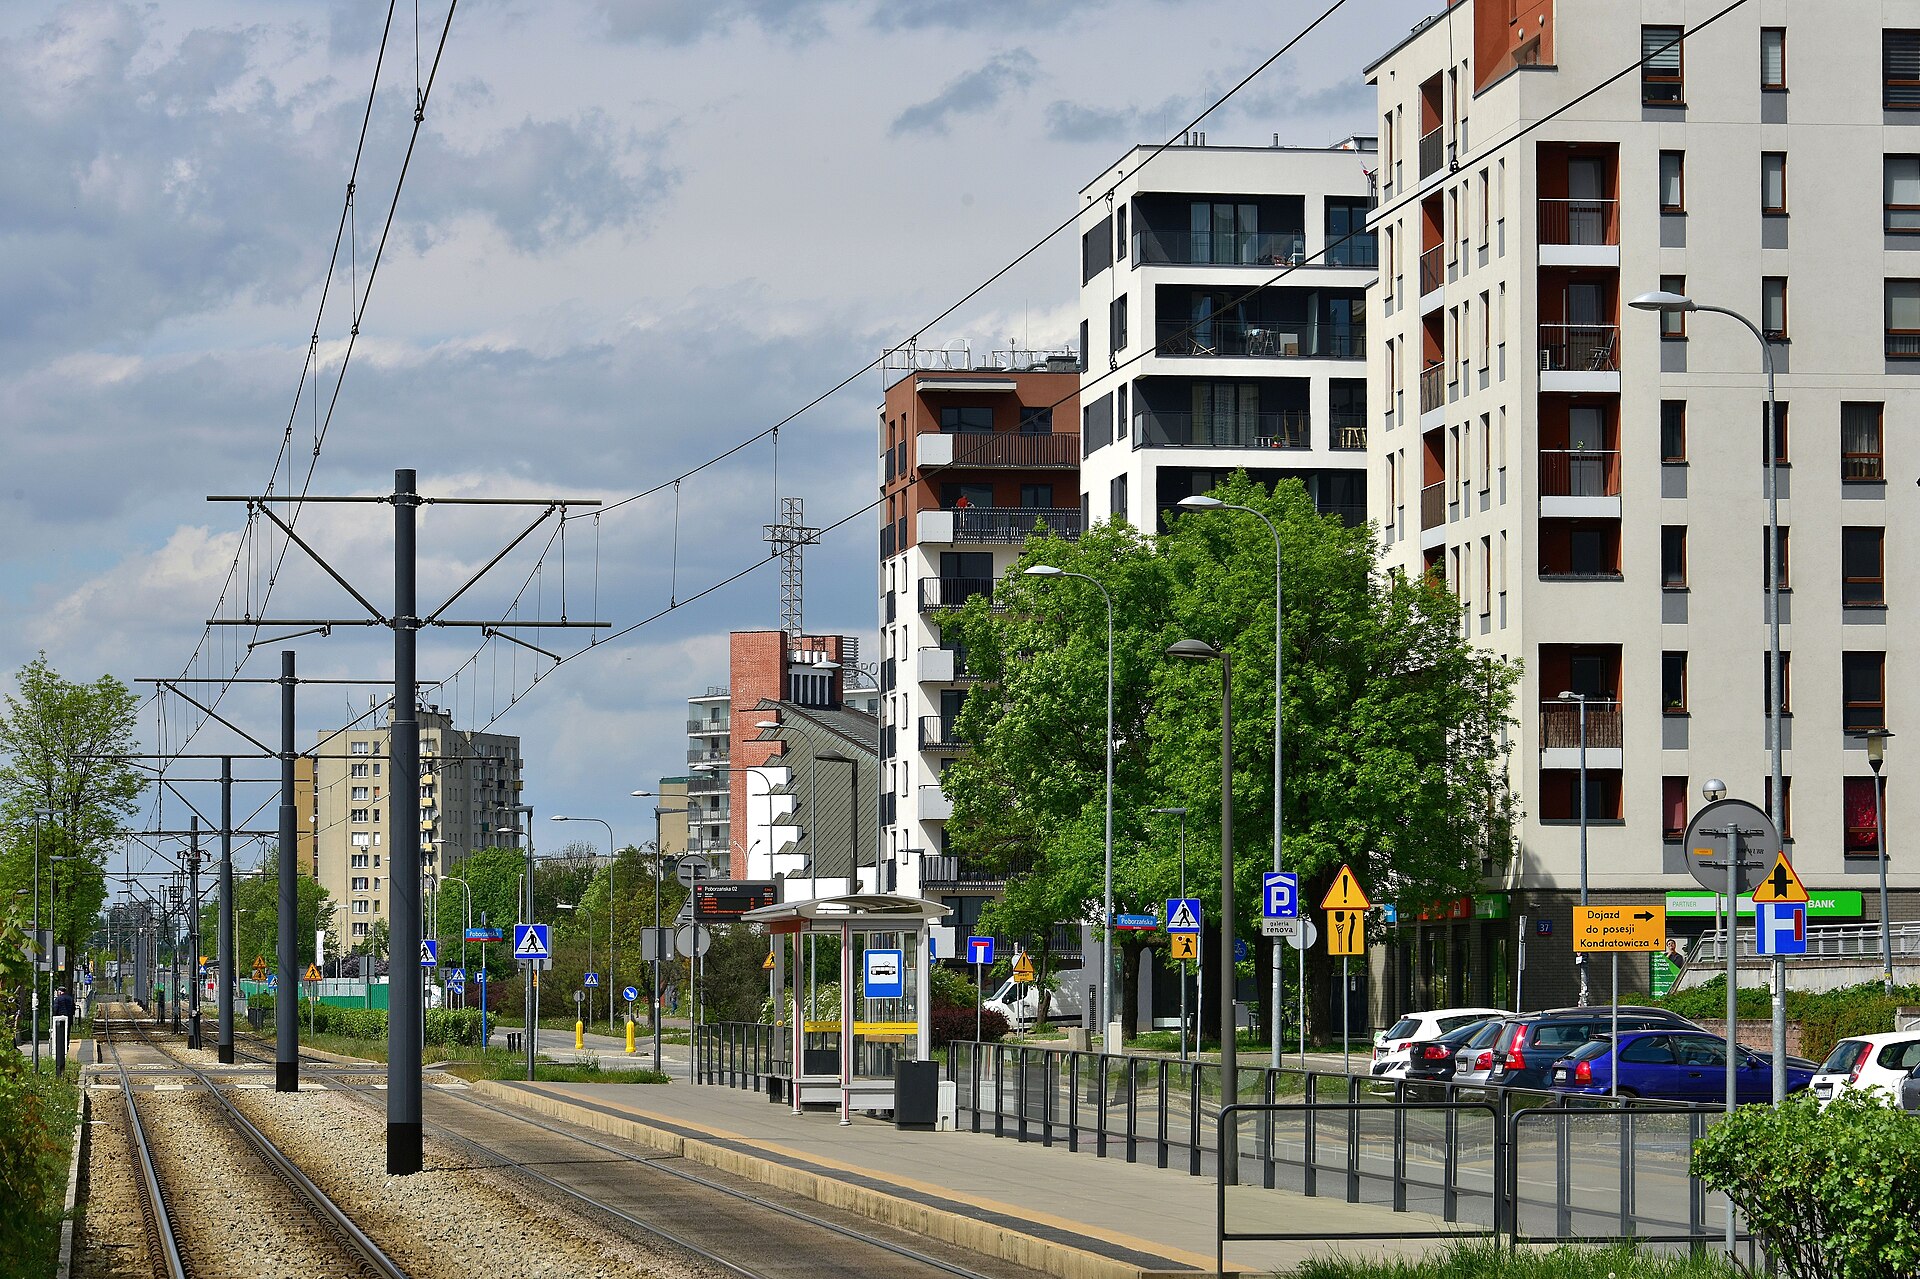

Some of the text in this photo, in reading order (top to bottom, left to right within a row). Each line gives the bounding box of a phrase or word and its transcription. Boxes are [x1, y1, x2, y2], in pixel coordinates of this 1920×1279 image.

[1271, 886, 1290, 914] P
[1807, 899, 1835, 908] BANK
[1587, 910, 1620, 921] Dojazd
[1121, 917, 1154, 925] Poborzańska
[1539, 923, 1549, 932] 37
[1585, 924, 1635, 936] do posesji
[1580, 938, 1660, 948] Kondratowicza 4
